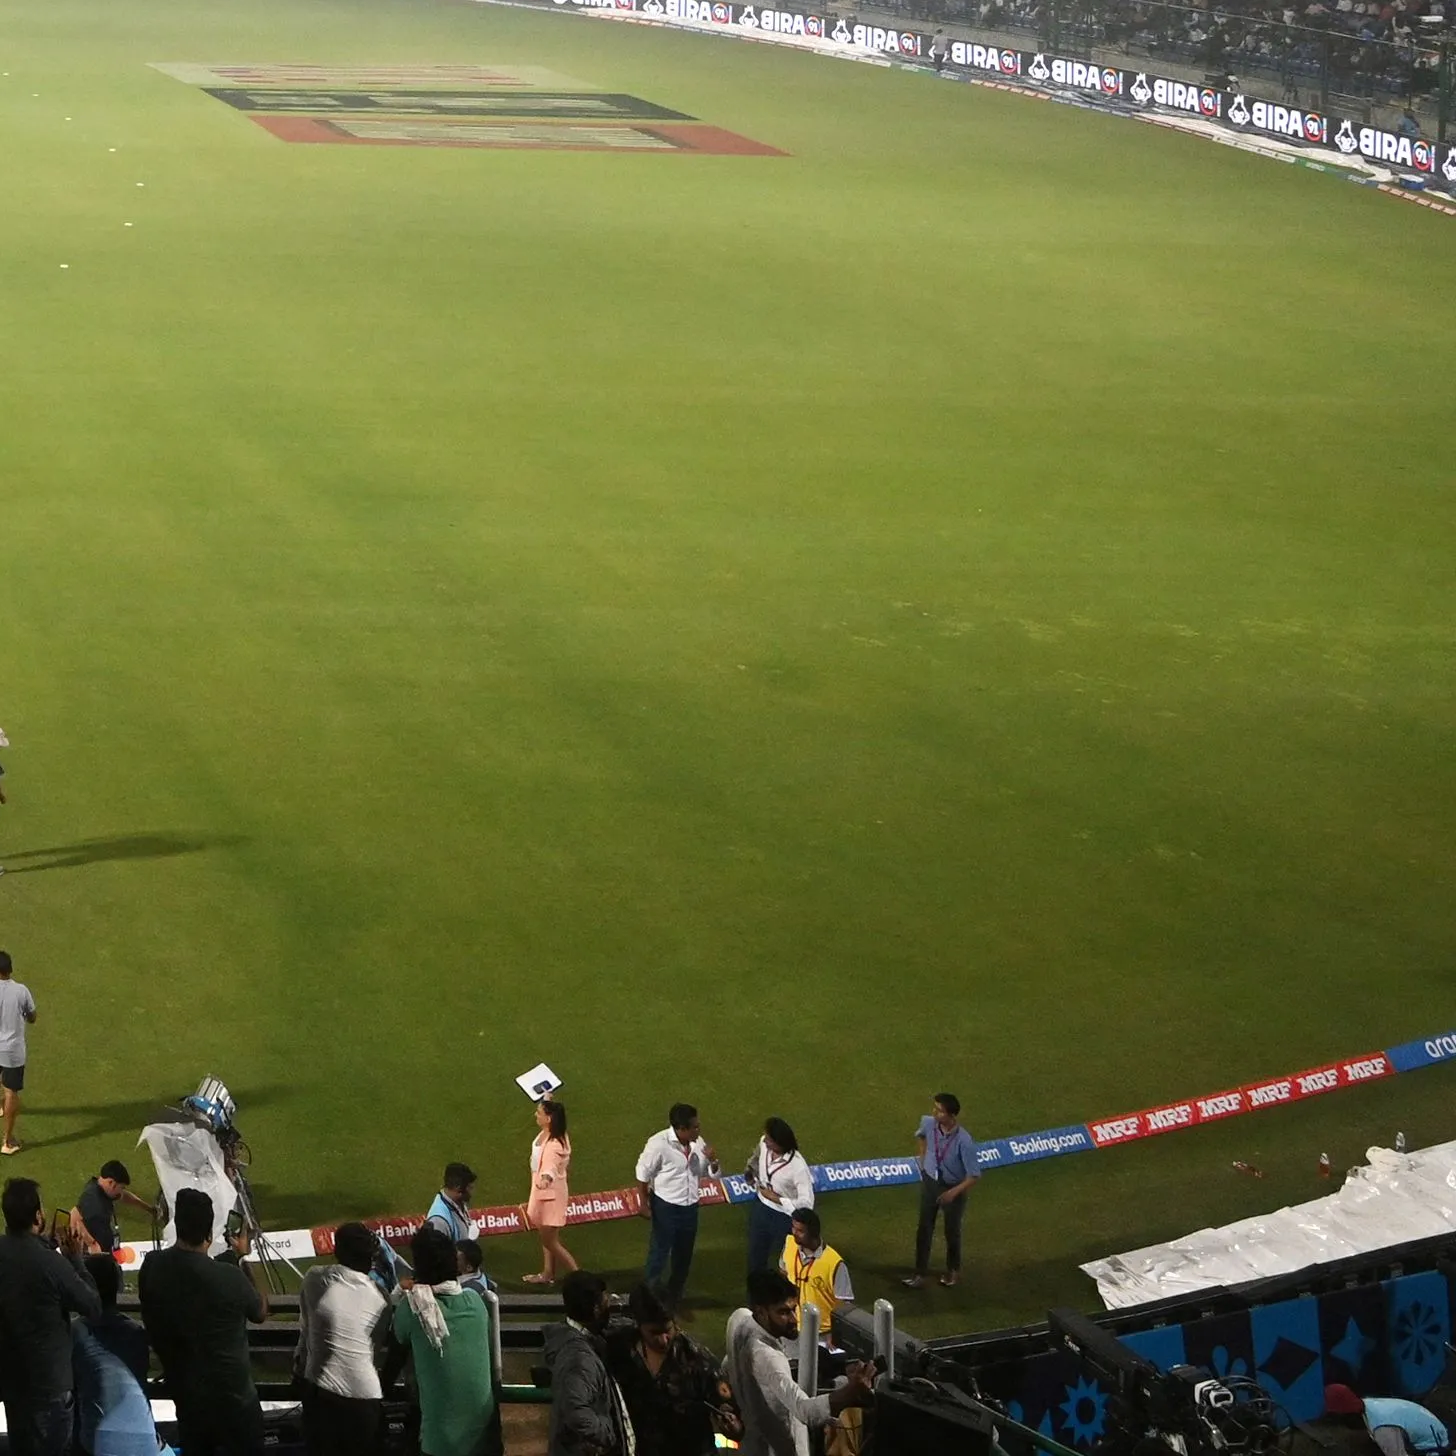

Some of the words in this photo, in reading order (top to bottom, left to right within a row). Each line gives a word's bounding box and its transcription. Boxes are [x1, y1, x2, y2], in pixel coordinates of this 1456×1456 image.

[761, 11, 805, 34] BIRA
[853, 26, 898, 51] BIRA
[951, 42, 999, 69] BIRA
[1052, 60, 1100, 88] BIRA
[1153, 79, 1199, 110] BIRA
[1253, 102, 1303, 137] BIRA
[1360, 127, 1412, 164] BIRA
[1092, 1118, 1140, 1142] MRF
[1146, 1105, 1191, 1130] MRF
[1197, 1094, 1241, 1117] MRF
[1248, 1082, 1291, 1107] MRF
[1296, 1069, 1338, 1093] MRF
[1344, 1058, 1386, 1081] MRF
[1009, 1132, 1086, 1157] Booking.com
[826, 1164, 912, 1183] Booking.com
[594, 1199, 624, 1214] Bank
[385, 1222, 417, 1238] Bank
[488, 1213, 519, 1227] Bank
